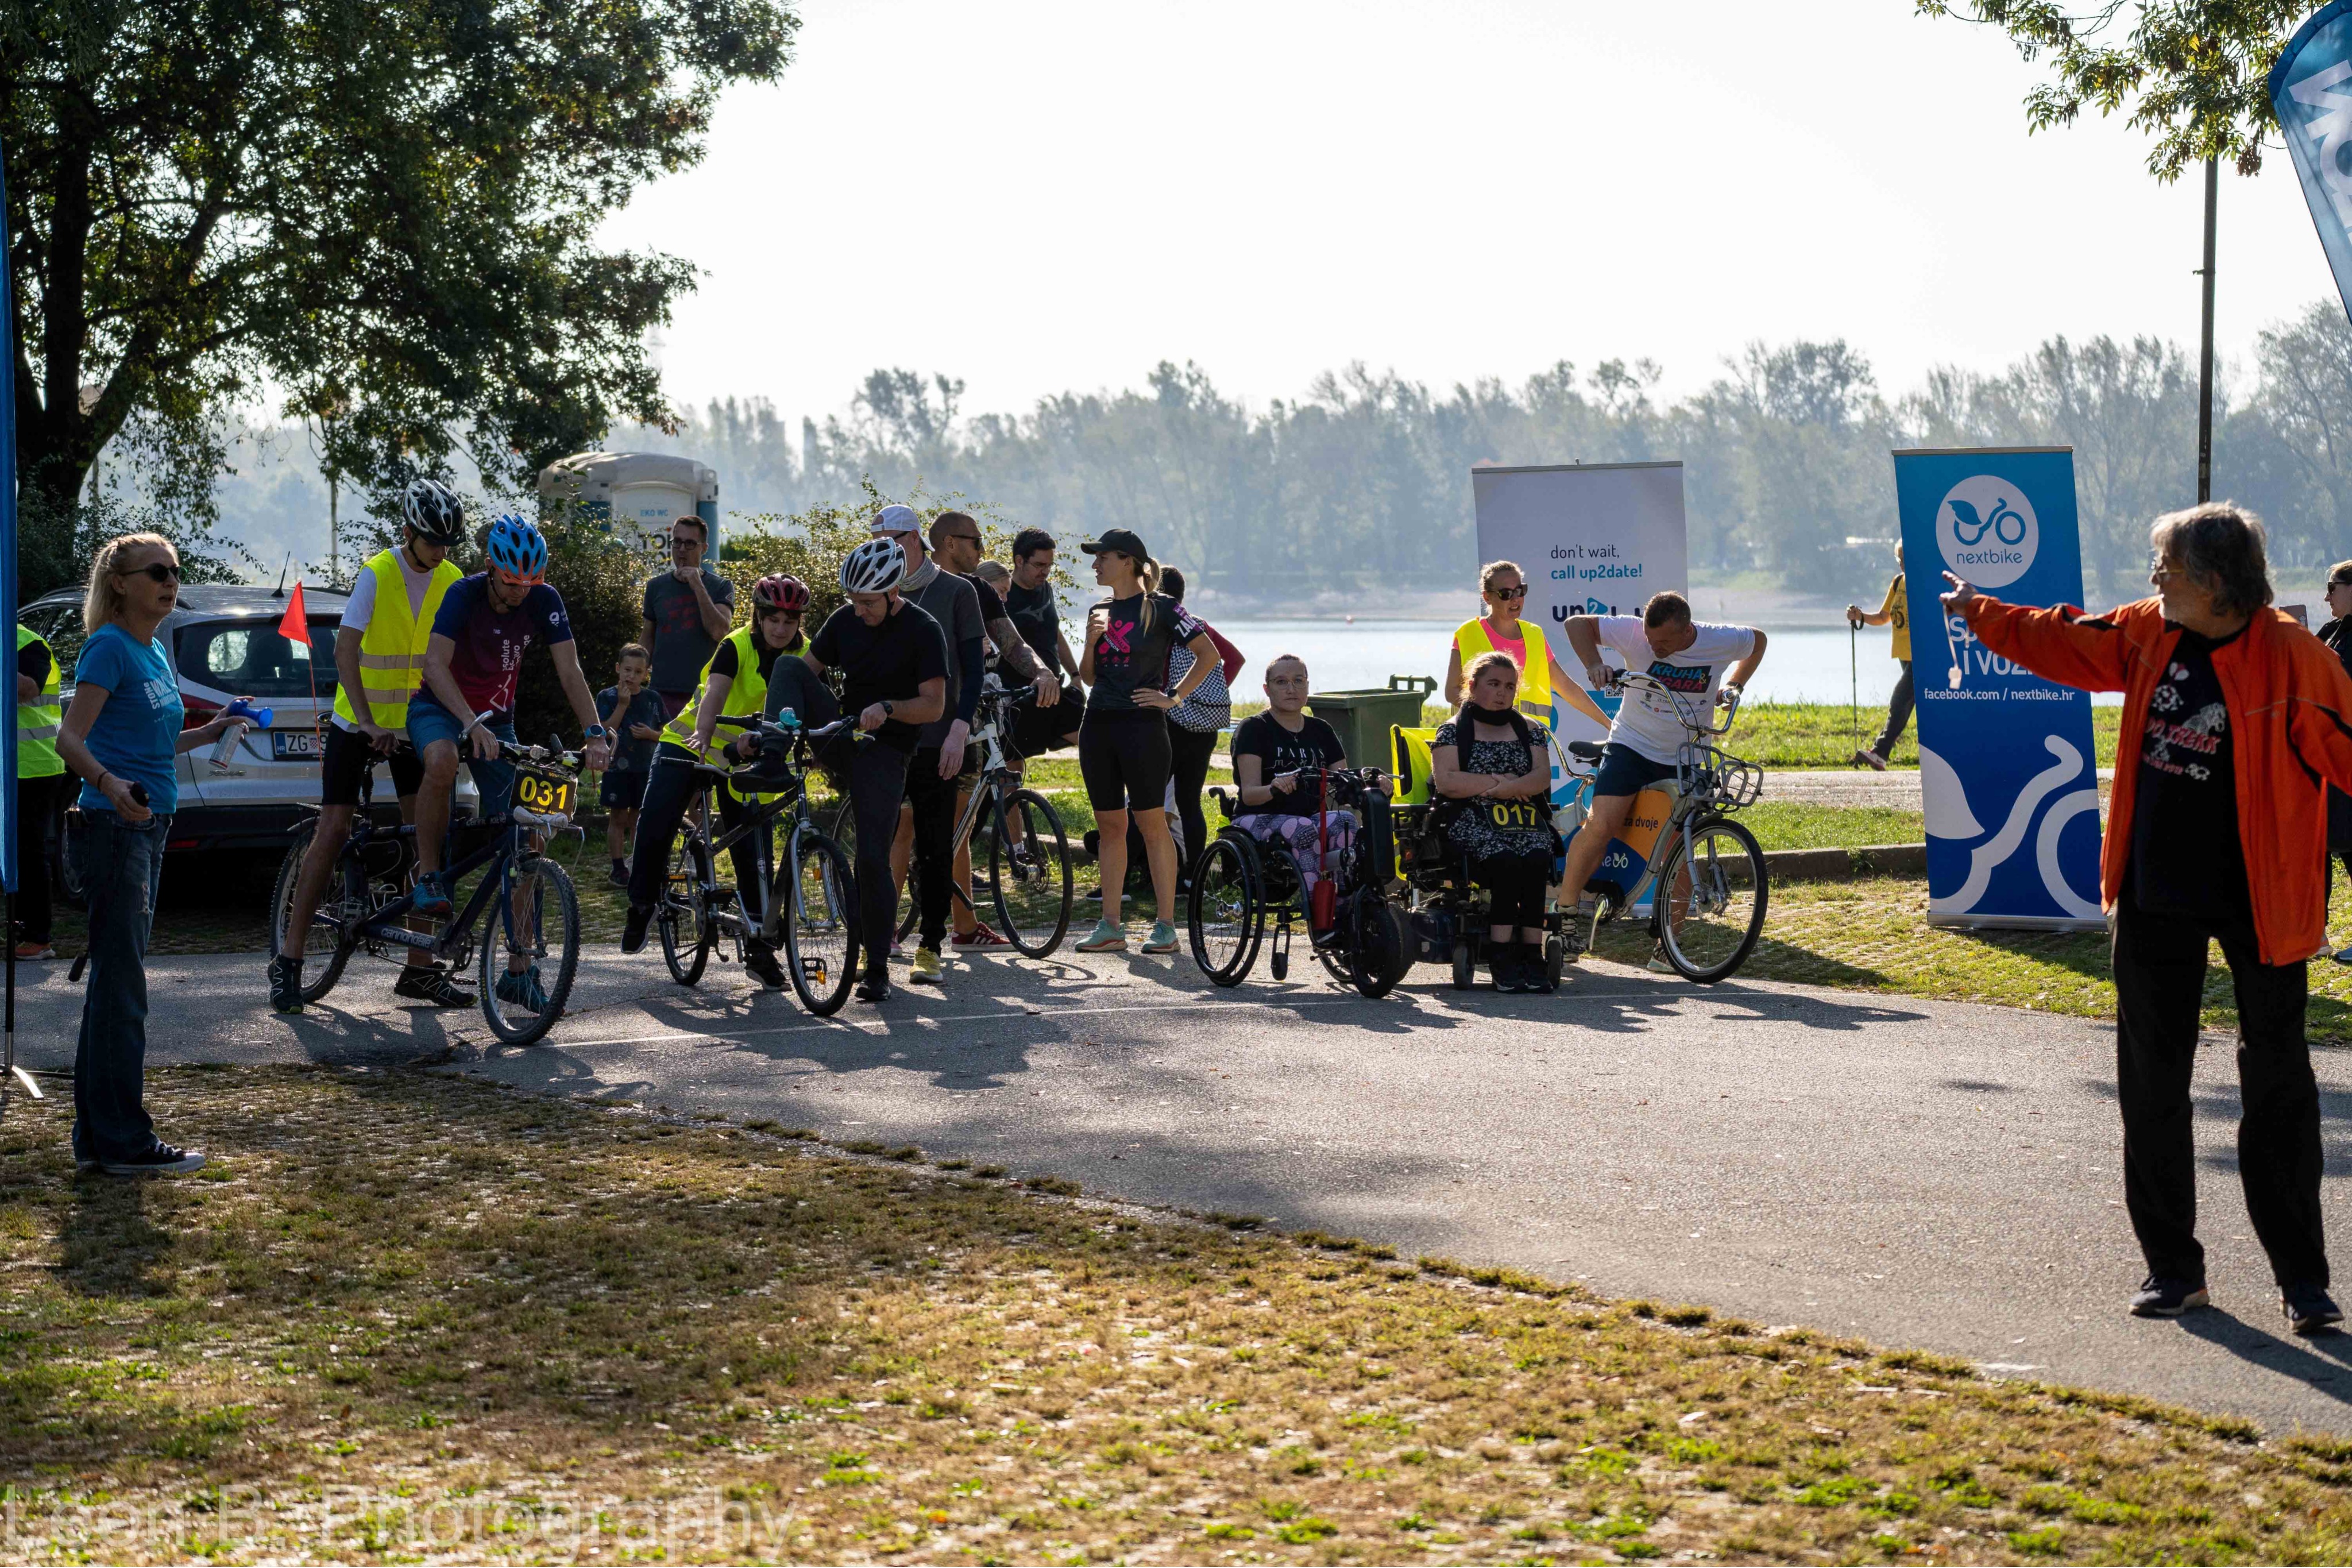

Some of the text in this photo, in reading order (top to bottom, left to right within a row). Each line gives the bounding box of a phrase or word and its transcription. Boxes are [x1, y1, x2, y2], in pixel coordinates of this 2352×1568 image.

[1551, 544, 1620, 559] don't wait,
[1956, 548, 2022, 564] nextbike
[1551, 563, 1642, 582] call up2date!
[1651, 663, 1703, 679] KRUHA
[1658, 676, 1703, 690] GARA
[1924, 688, 2000, 700] facebook.com
[2011, 689, 2075, 701] nextbike.hr
[287, 735, 308, 752] ZG
[520, 777, 567, 809] 031
[1493, 804, 1536, 826] 017
[1635, 816, 1659, 831] dvoje
[381, 928, 432, 948] cannondale
